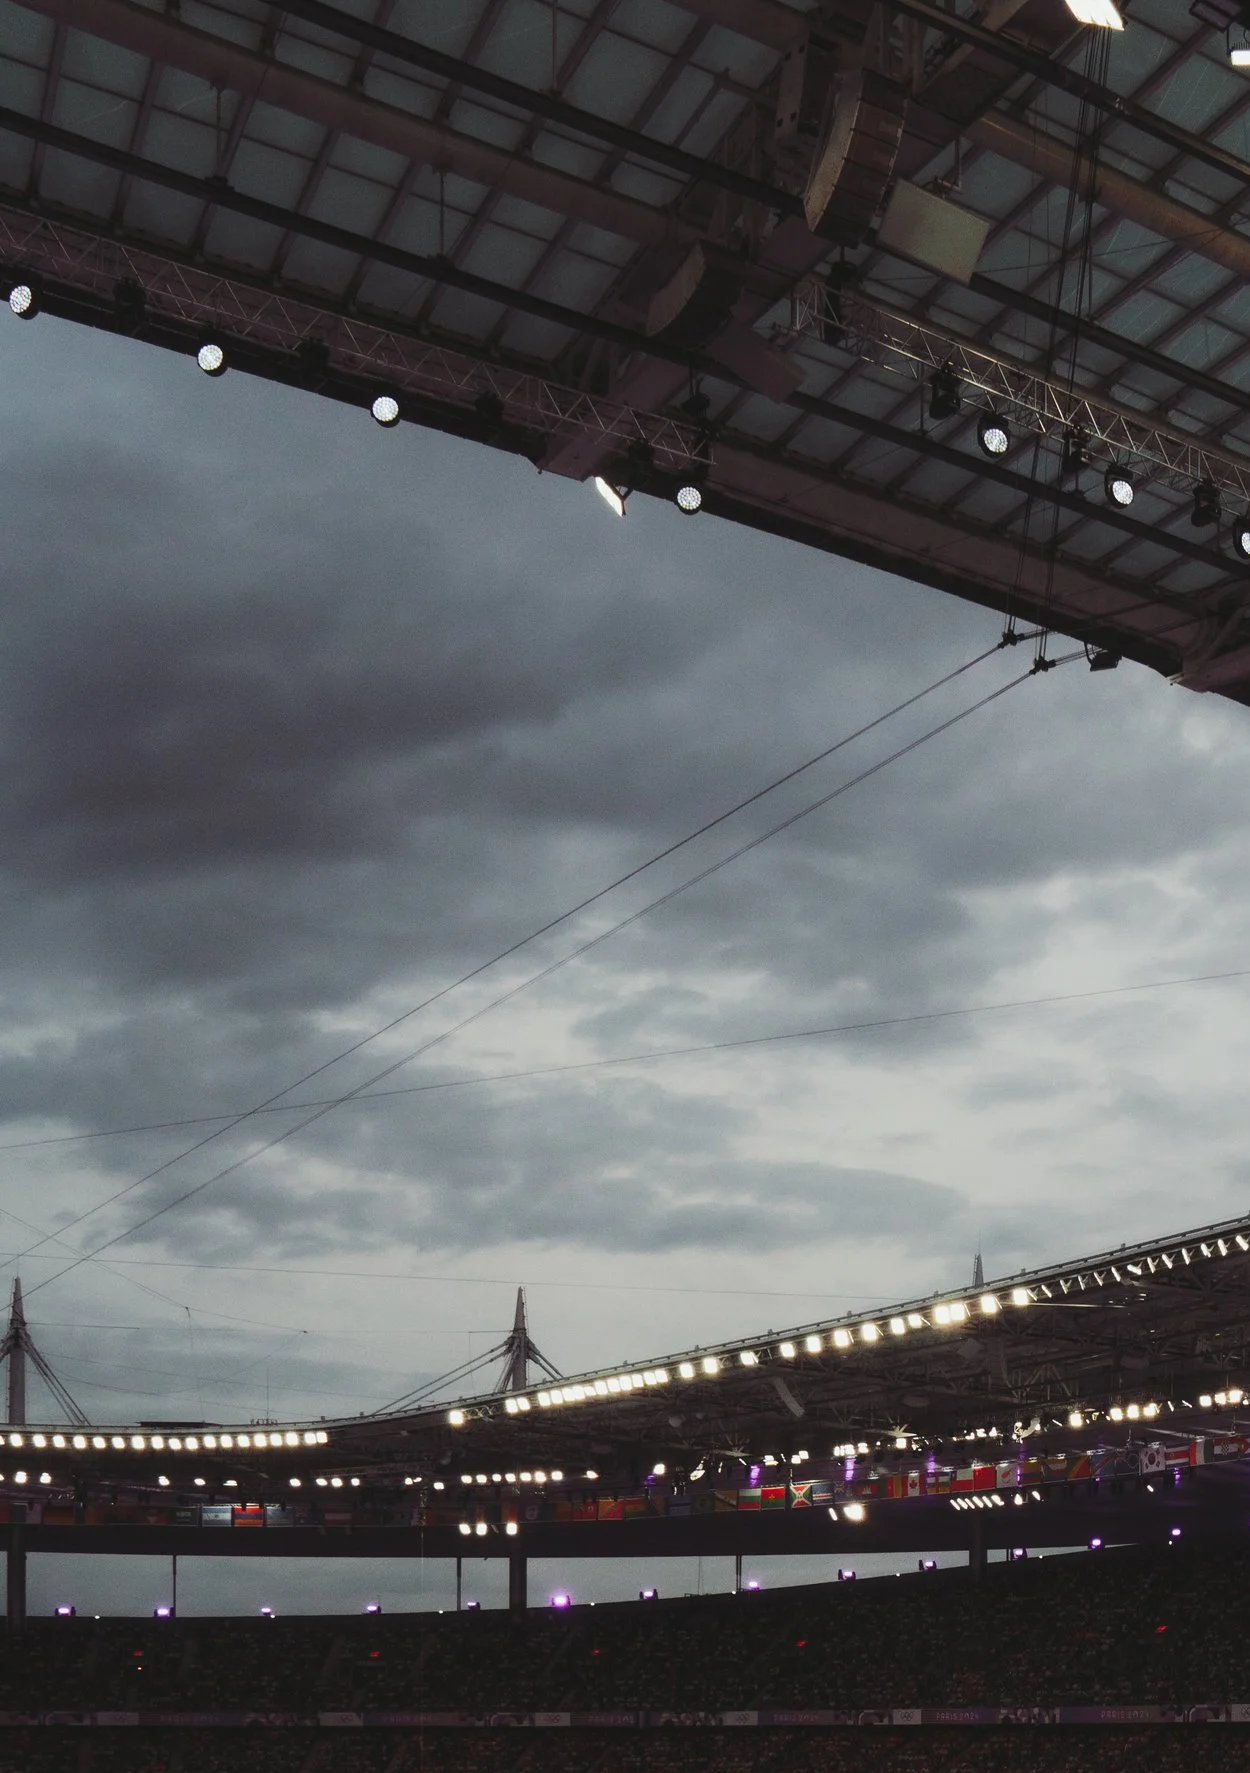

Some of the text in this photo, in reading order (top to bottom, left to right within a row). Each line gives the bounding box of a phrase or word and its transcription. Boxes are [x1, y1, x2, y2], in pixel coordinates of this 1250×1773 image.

[936, 1712, 979, 1720] PARIS 2024
[1100, 1710, 1149, 1719] PARIS 2024
